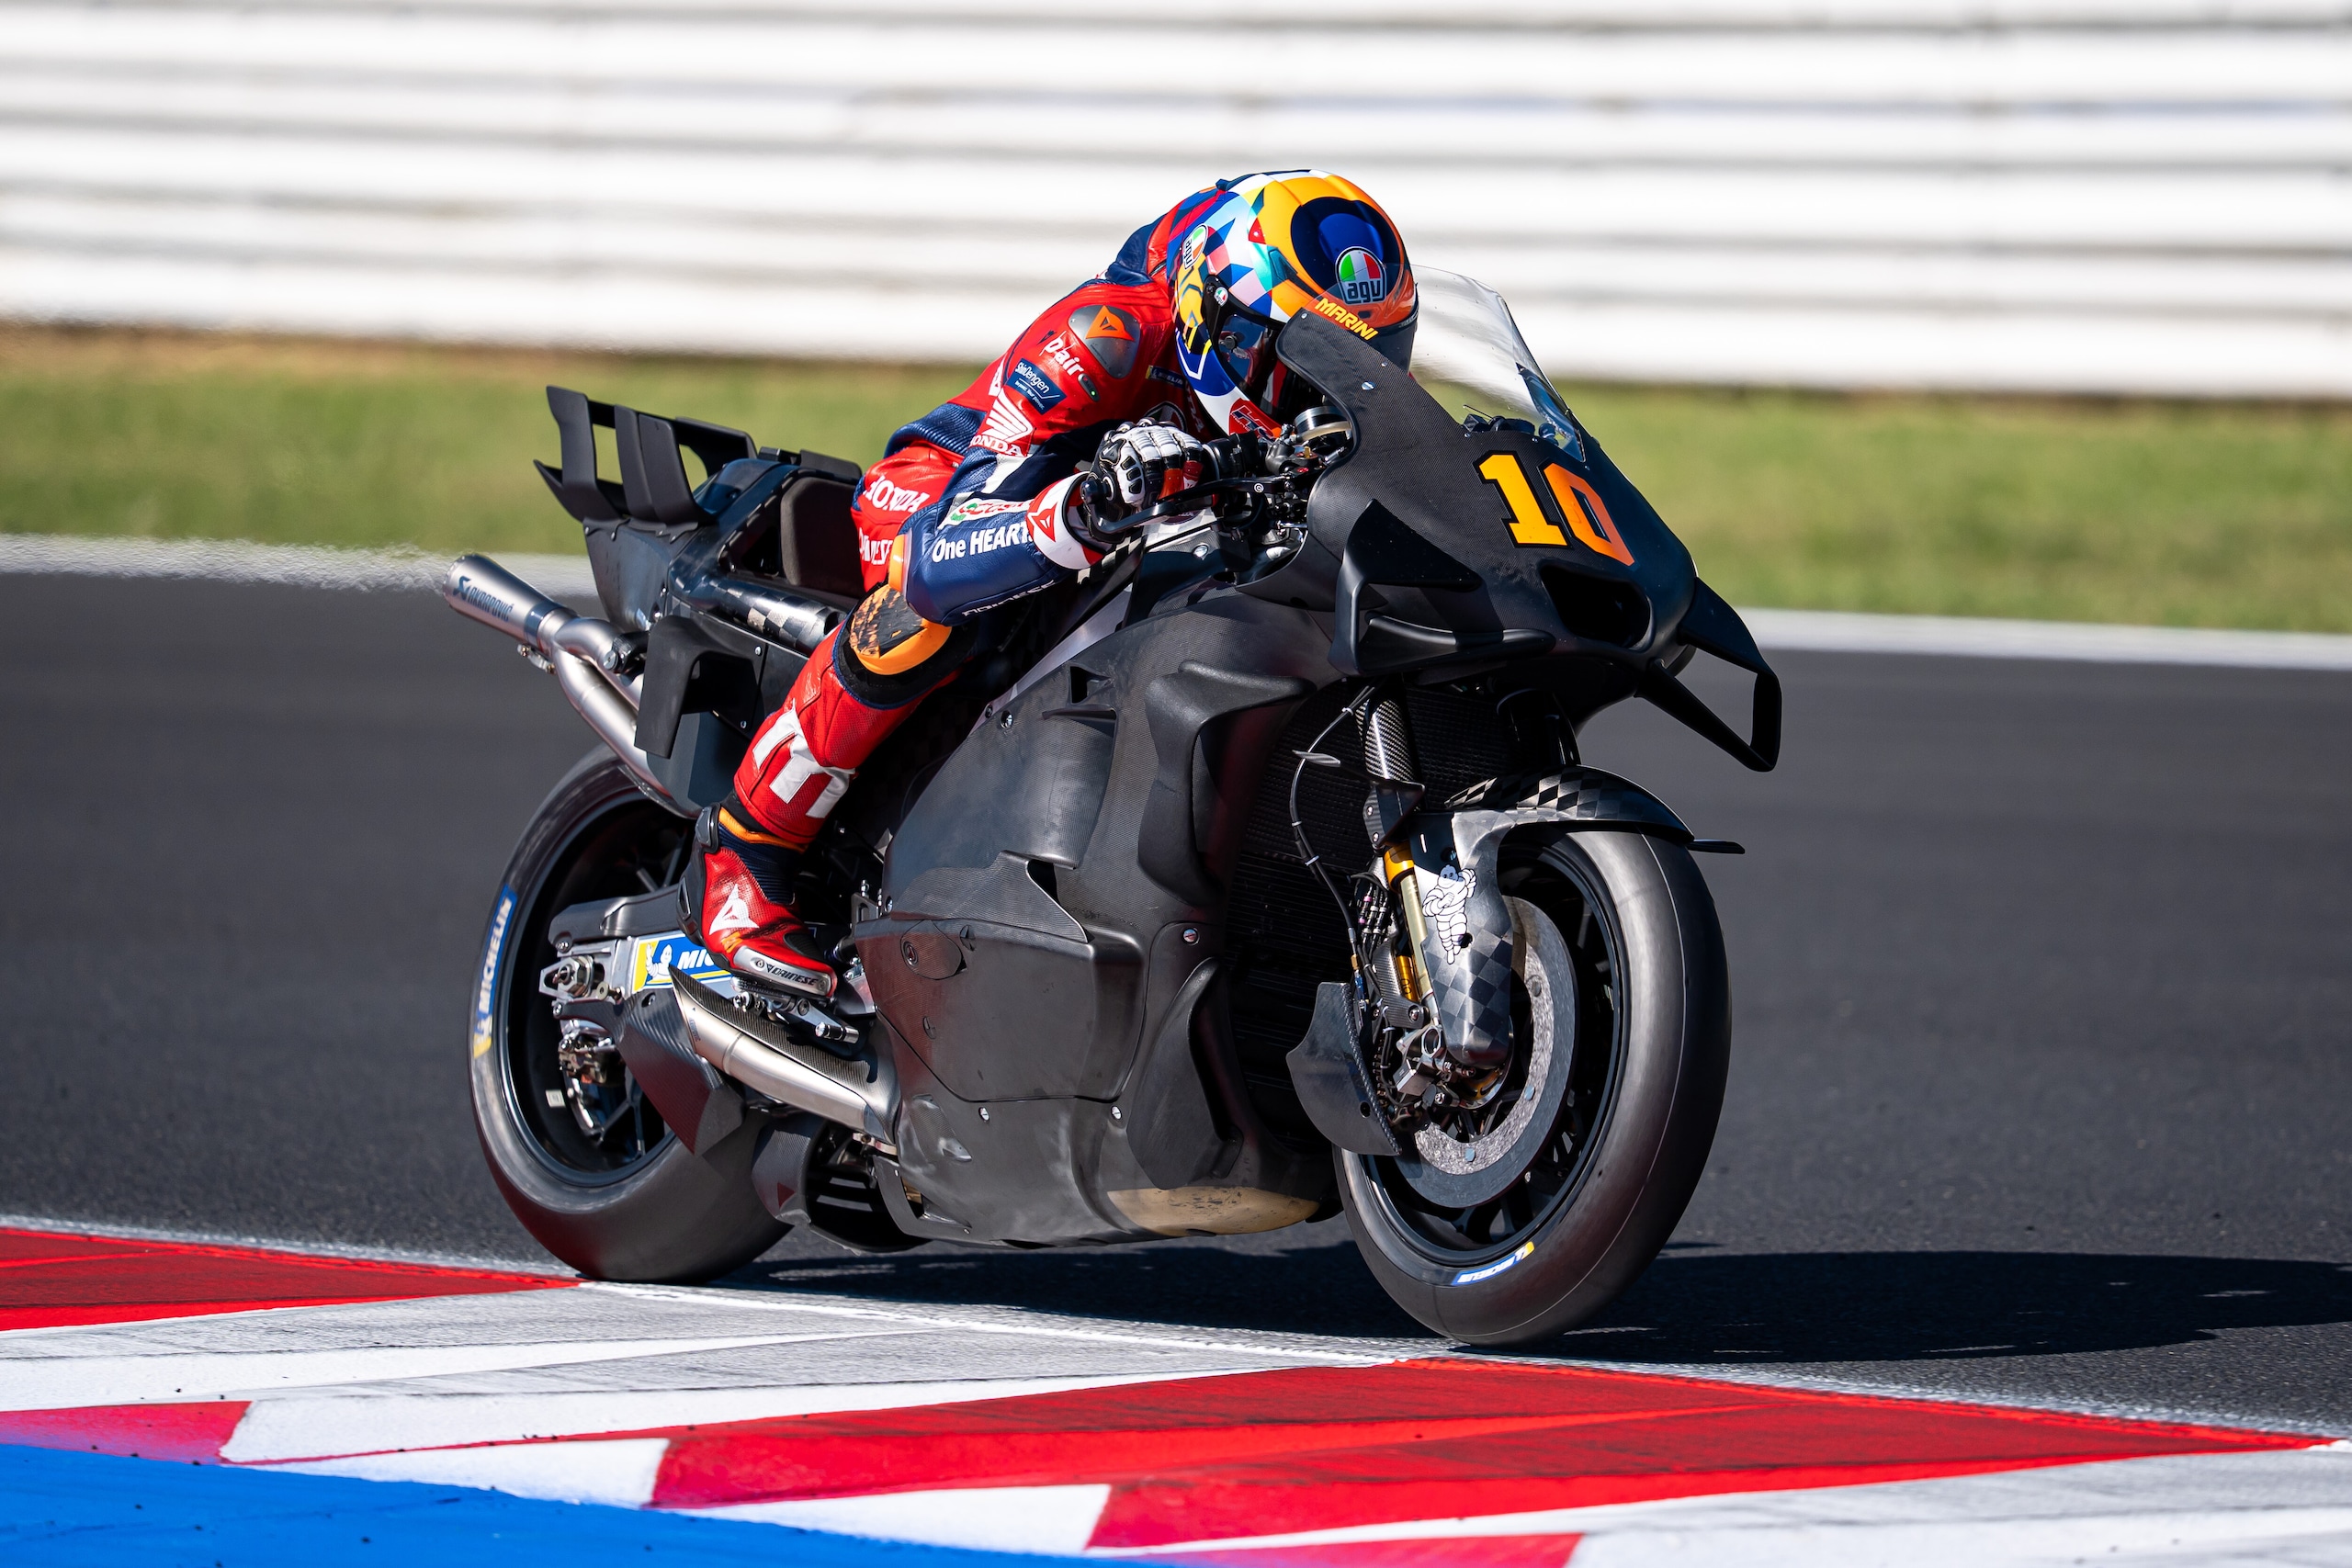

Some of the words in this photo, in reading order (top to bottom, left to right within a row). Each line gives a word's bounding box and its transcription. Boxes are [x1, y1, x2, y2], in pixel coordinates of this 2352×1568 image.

[1315, 298, 1378, 340] MARINI
[1476, 453, 1636, 568] 10
[932, 538, 967, 563] One
[478, 897, 513, 1015] MICHELIN
[771, 967, 819, 986] DAINESE
